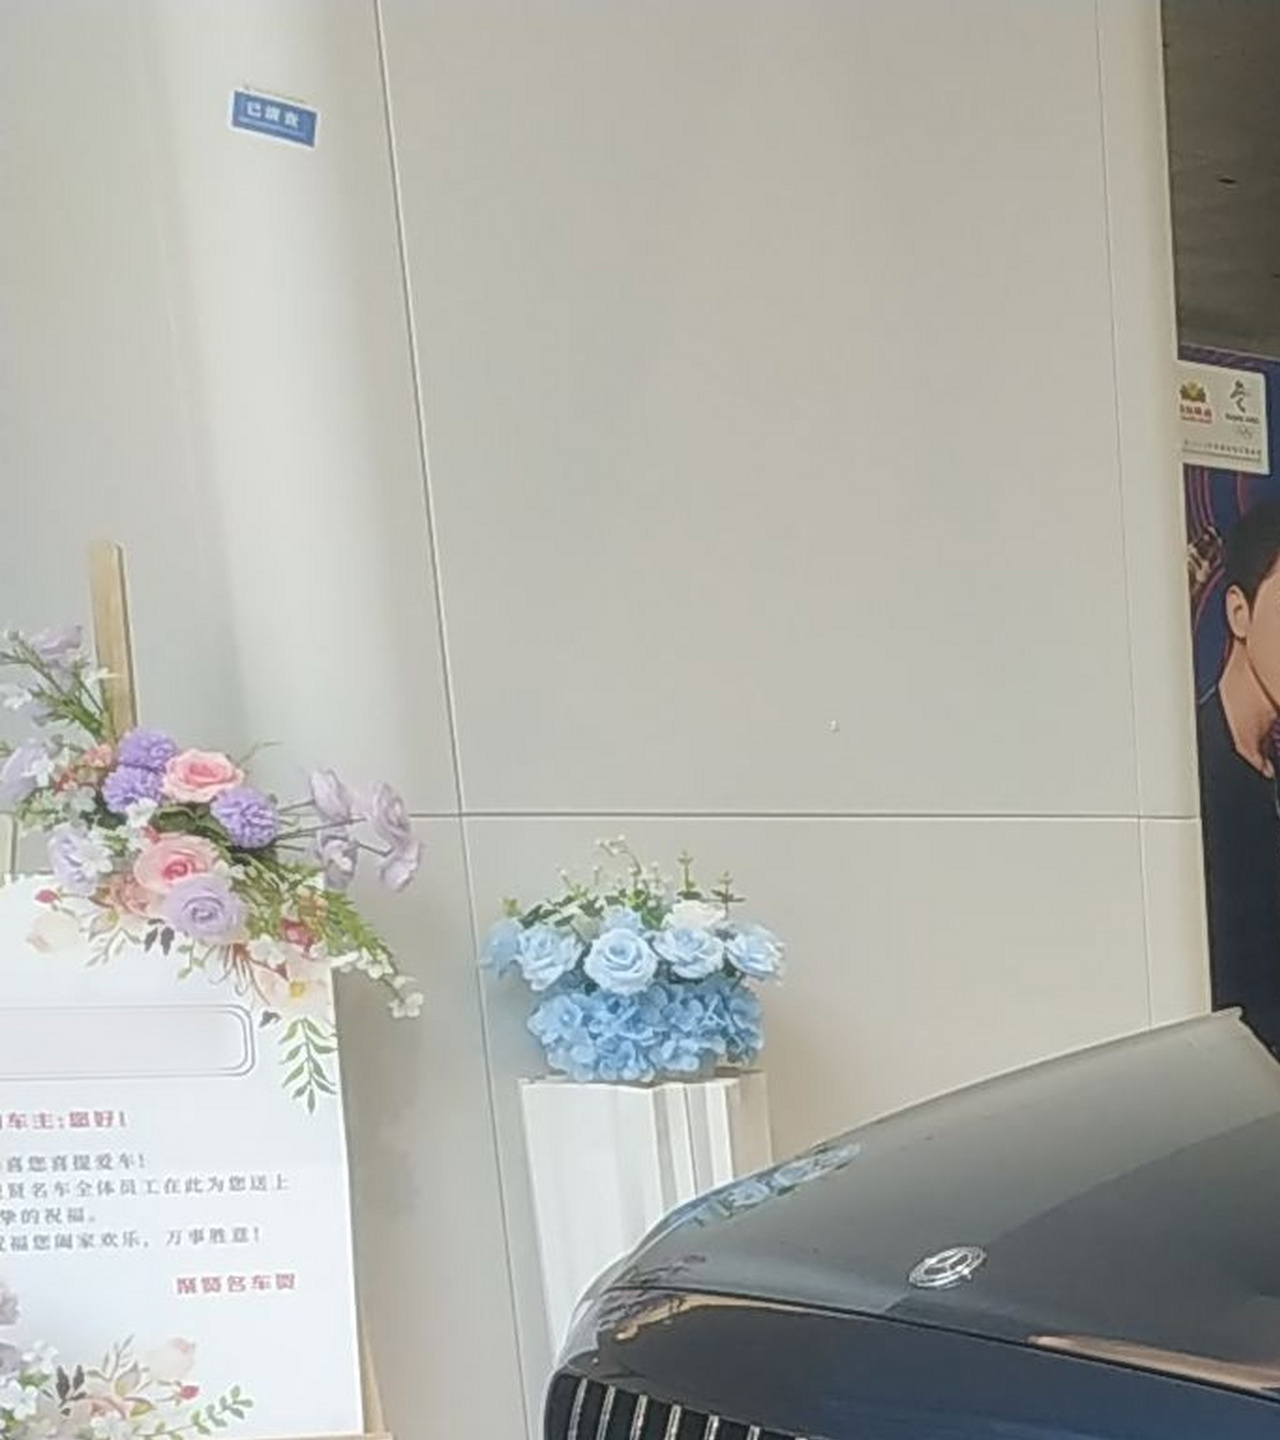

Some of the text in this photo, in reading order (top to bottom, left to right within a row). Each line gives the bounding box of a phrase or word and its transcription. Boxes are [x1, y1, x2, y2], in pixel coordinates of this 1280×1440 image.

[0, 1110, 128, 1130] 车主：您好！
[0, 1153, 146, 1173] 喜您喜提爱车！
[0, 1174, 291, 1199] 贤名车全体员工在此为您送上
